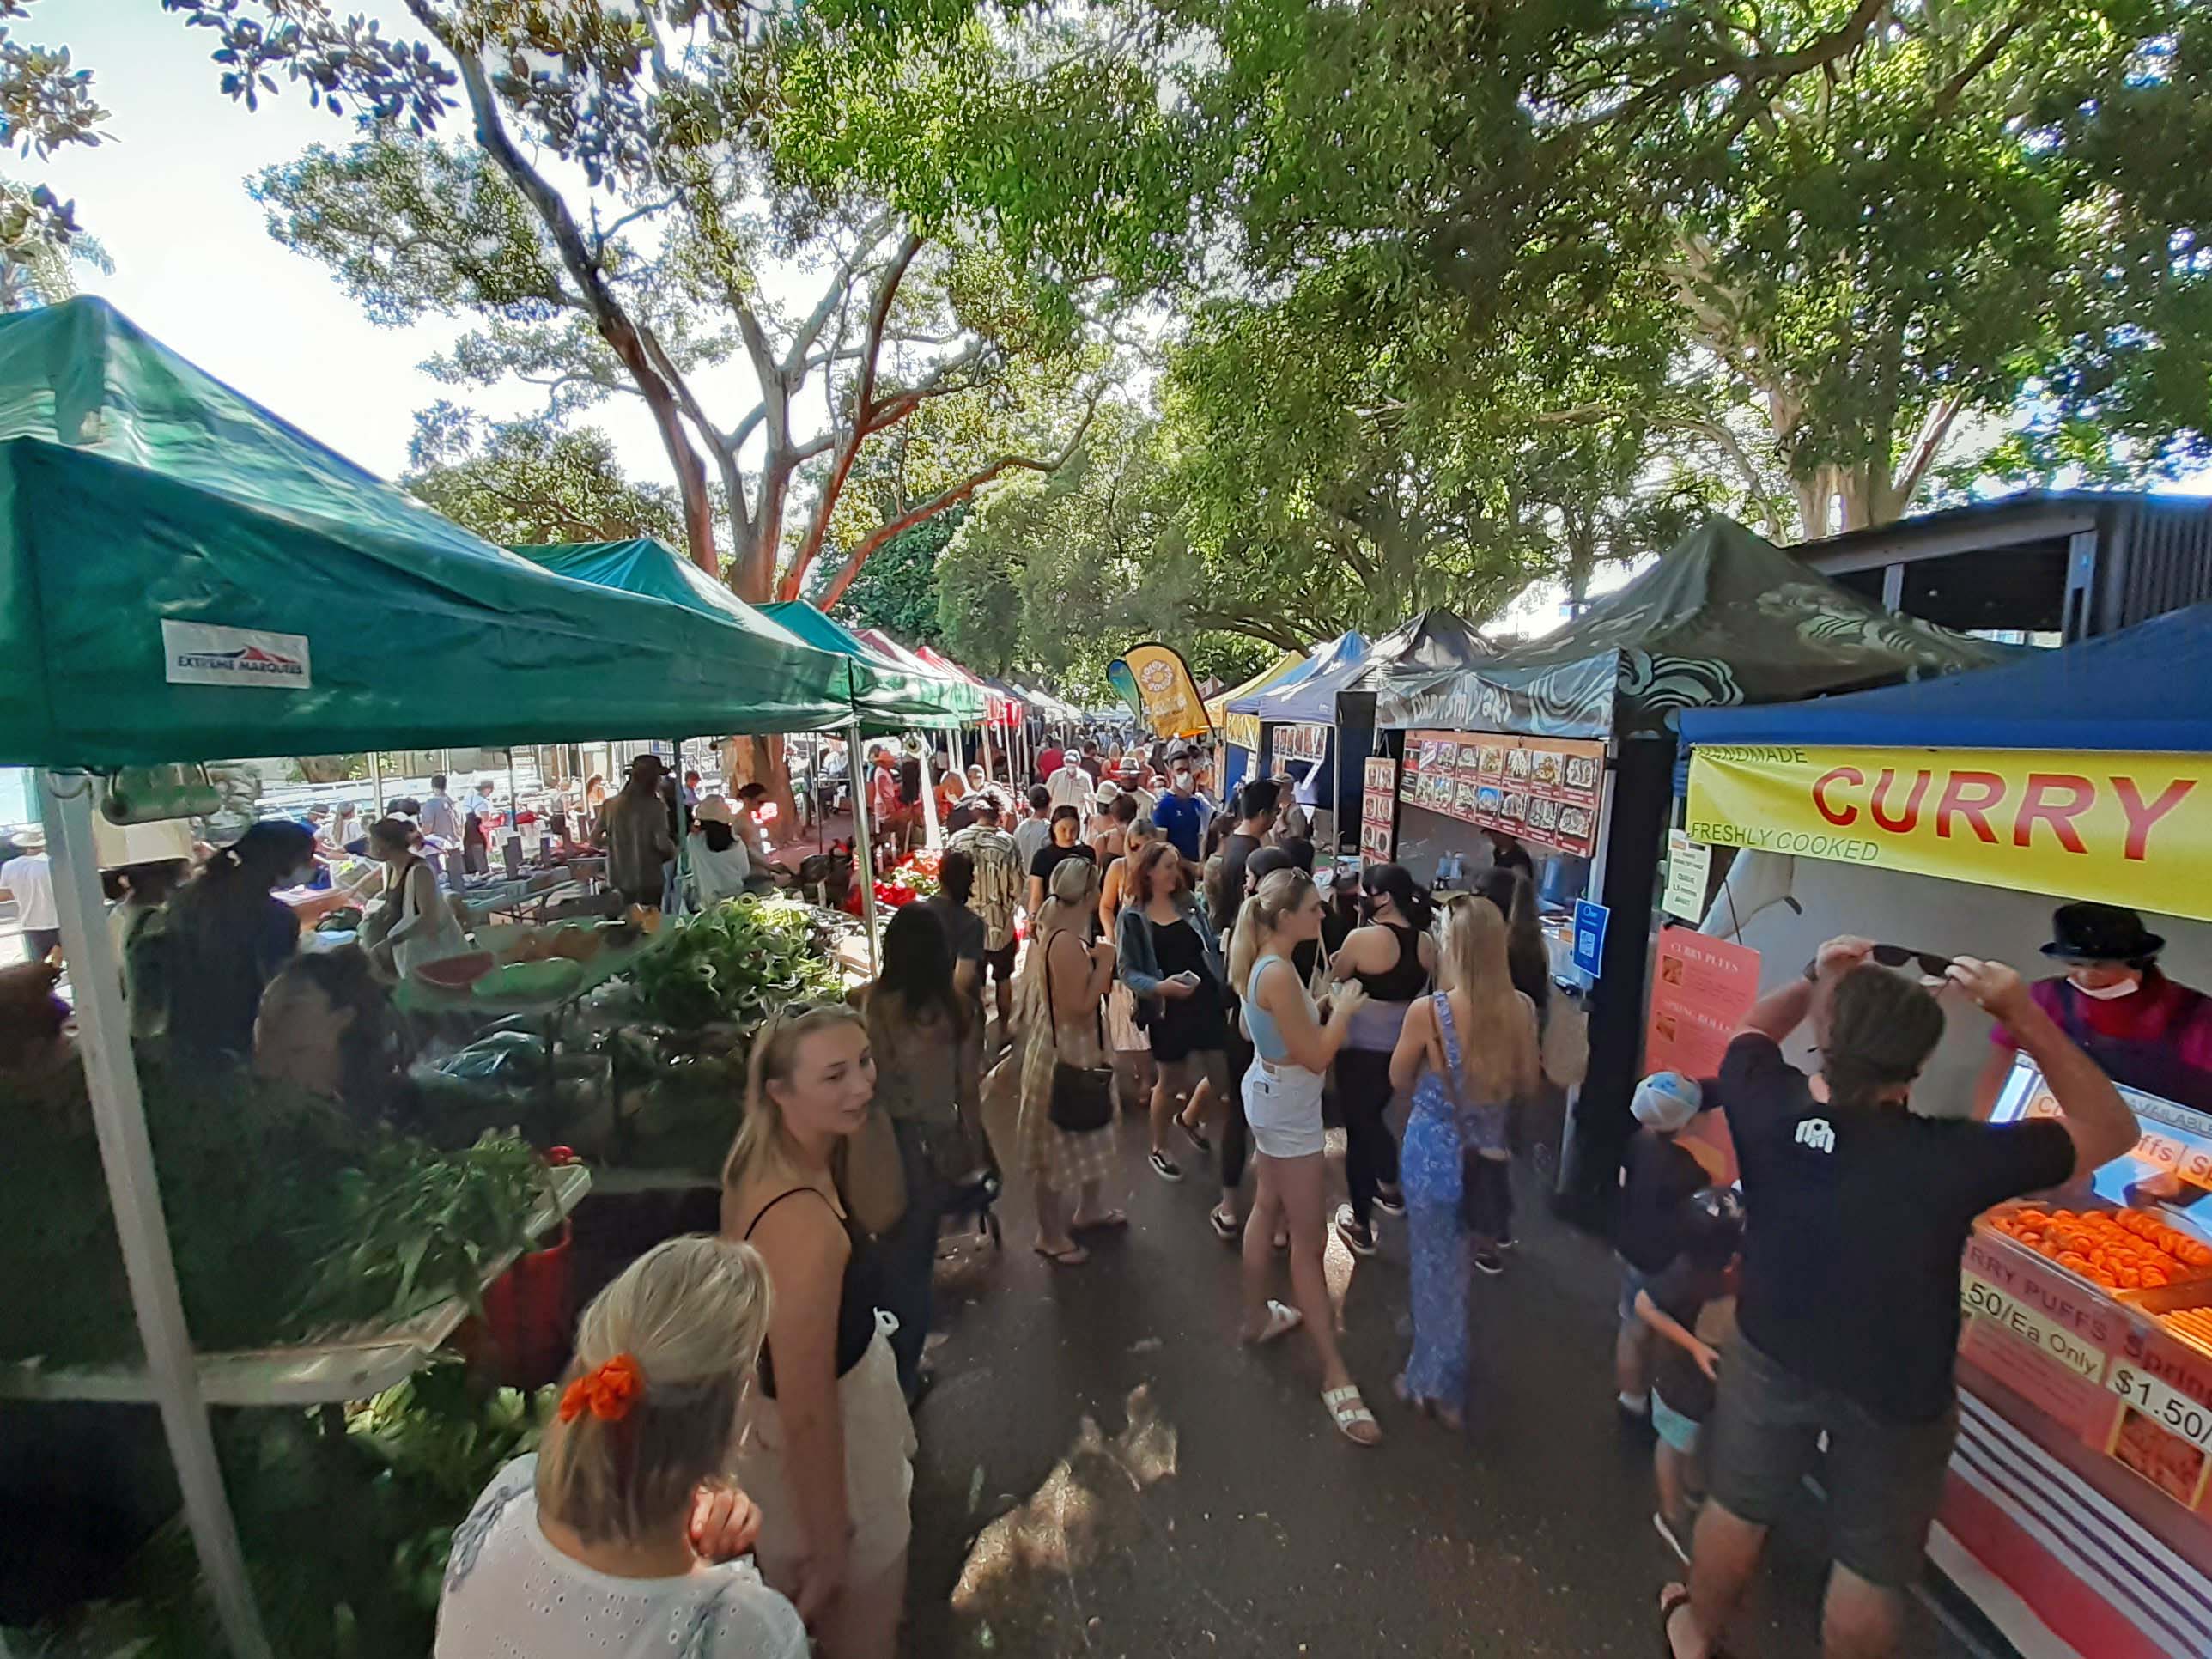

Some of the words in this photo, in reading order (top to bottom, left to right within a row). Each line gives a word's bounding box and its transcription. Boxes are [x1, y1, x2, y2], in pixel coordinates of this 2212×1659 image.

[179, 656, 234, 670] EXTREME
[1812, 767, 2199, 861] CURRY
[1688, 822, 1772, 846] FRESHLY
[1776, 832, 1879, 861] COOKED
[2024, 1280, 2108, 1341] PUFFS
[2050, 1334, 2098, 1374] Only
